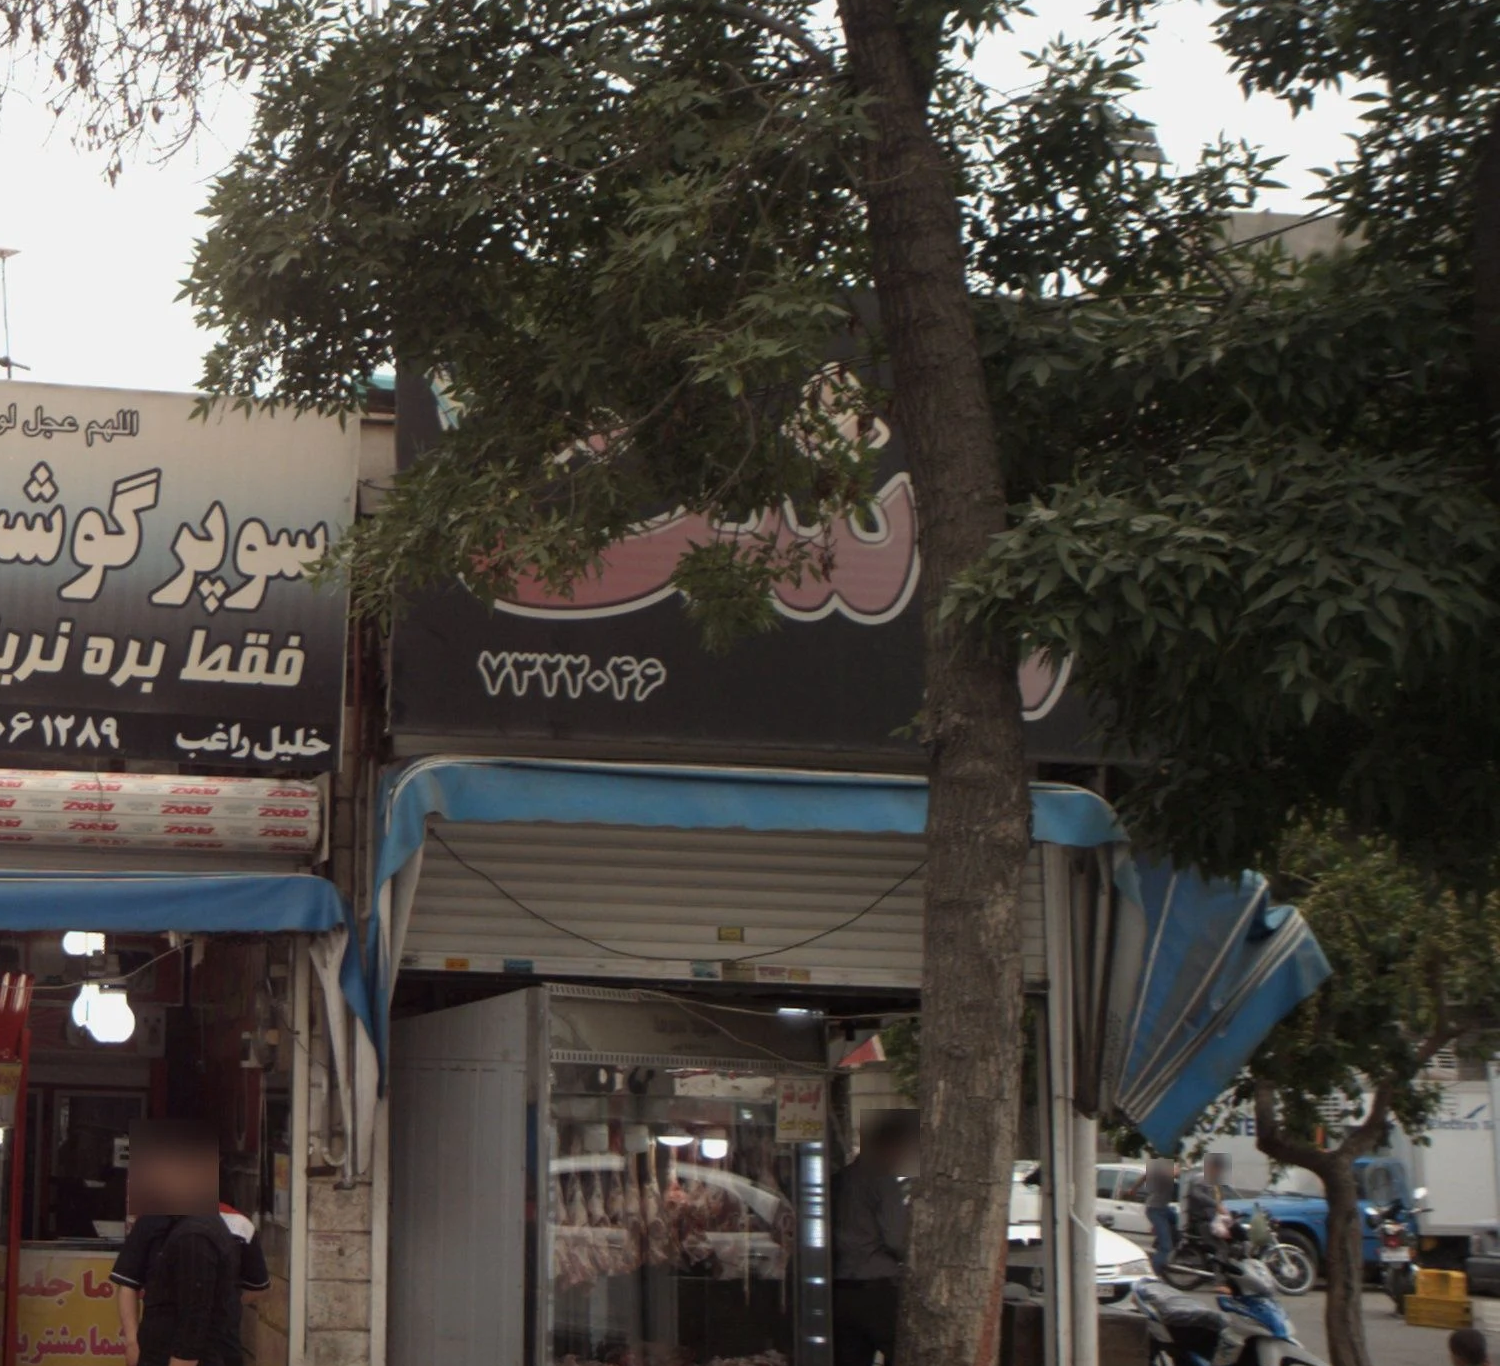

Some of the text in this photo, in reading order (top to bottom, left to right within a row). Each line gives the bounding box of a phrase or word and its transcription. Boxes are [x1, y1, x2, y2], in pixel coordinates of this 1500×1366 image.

[23, 406, 79, 439] عجل
[85, 409, 139, 447] اللهم
[150, 501, 329, 613] سوپر
[82, 637, 166, 693] بره
[180, 628, 305, 688] فقط
[477, 650, 667, 702] ۷۳۲۲۰۴۶
[175, 722, 250, 759] راغب
[254, 724, 331, 761] خلیل
[82, 1270, 114, 1299] ما
